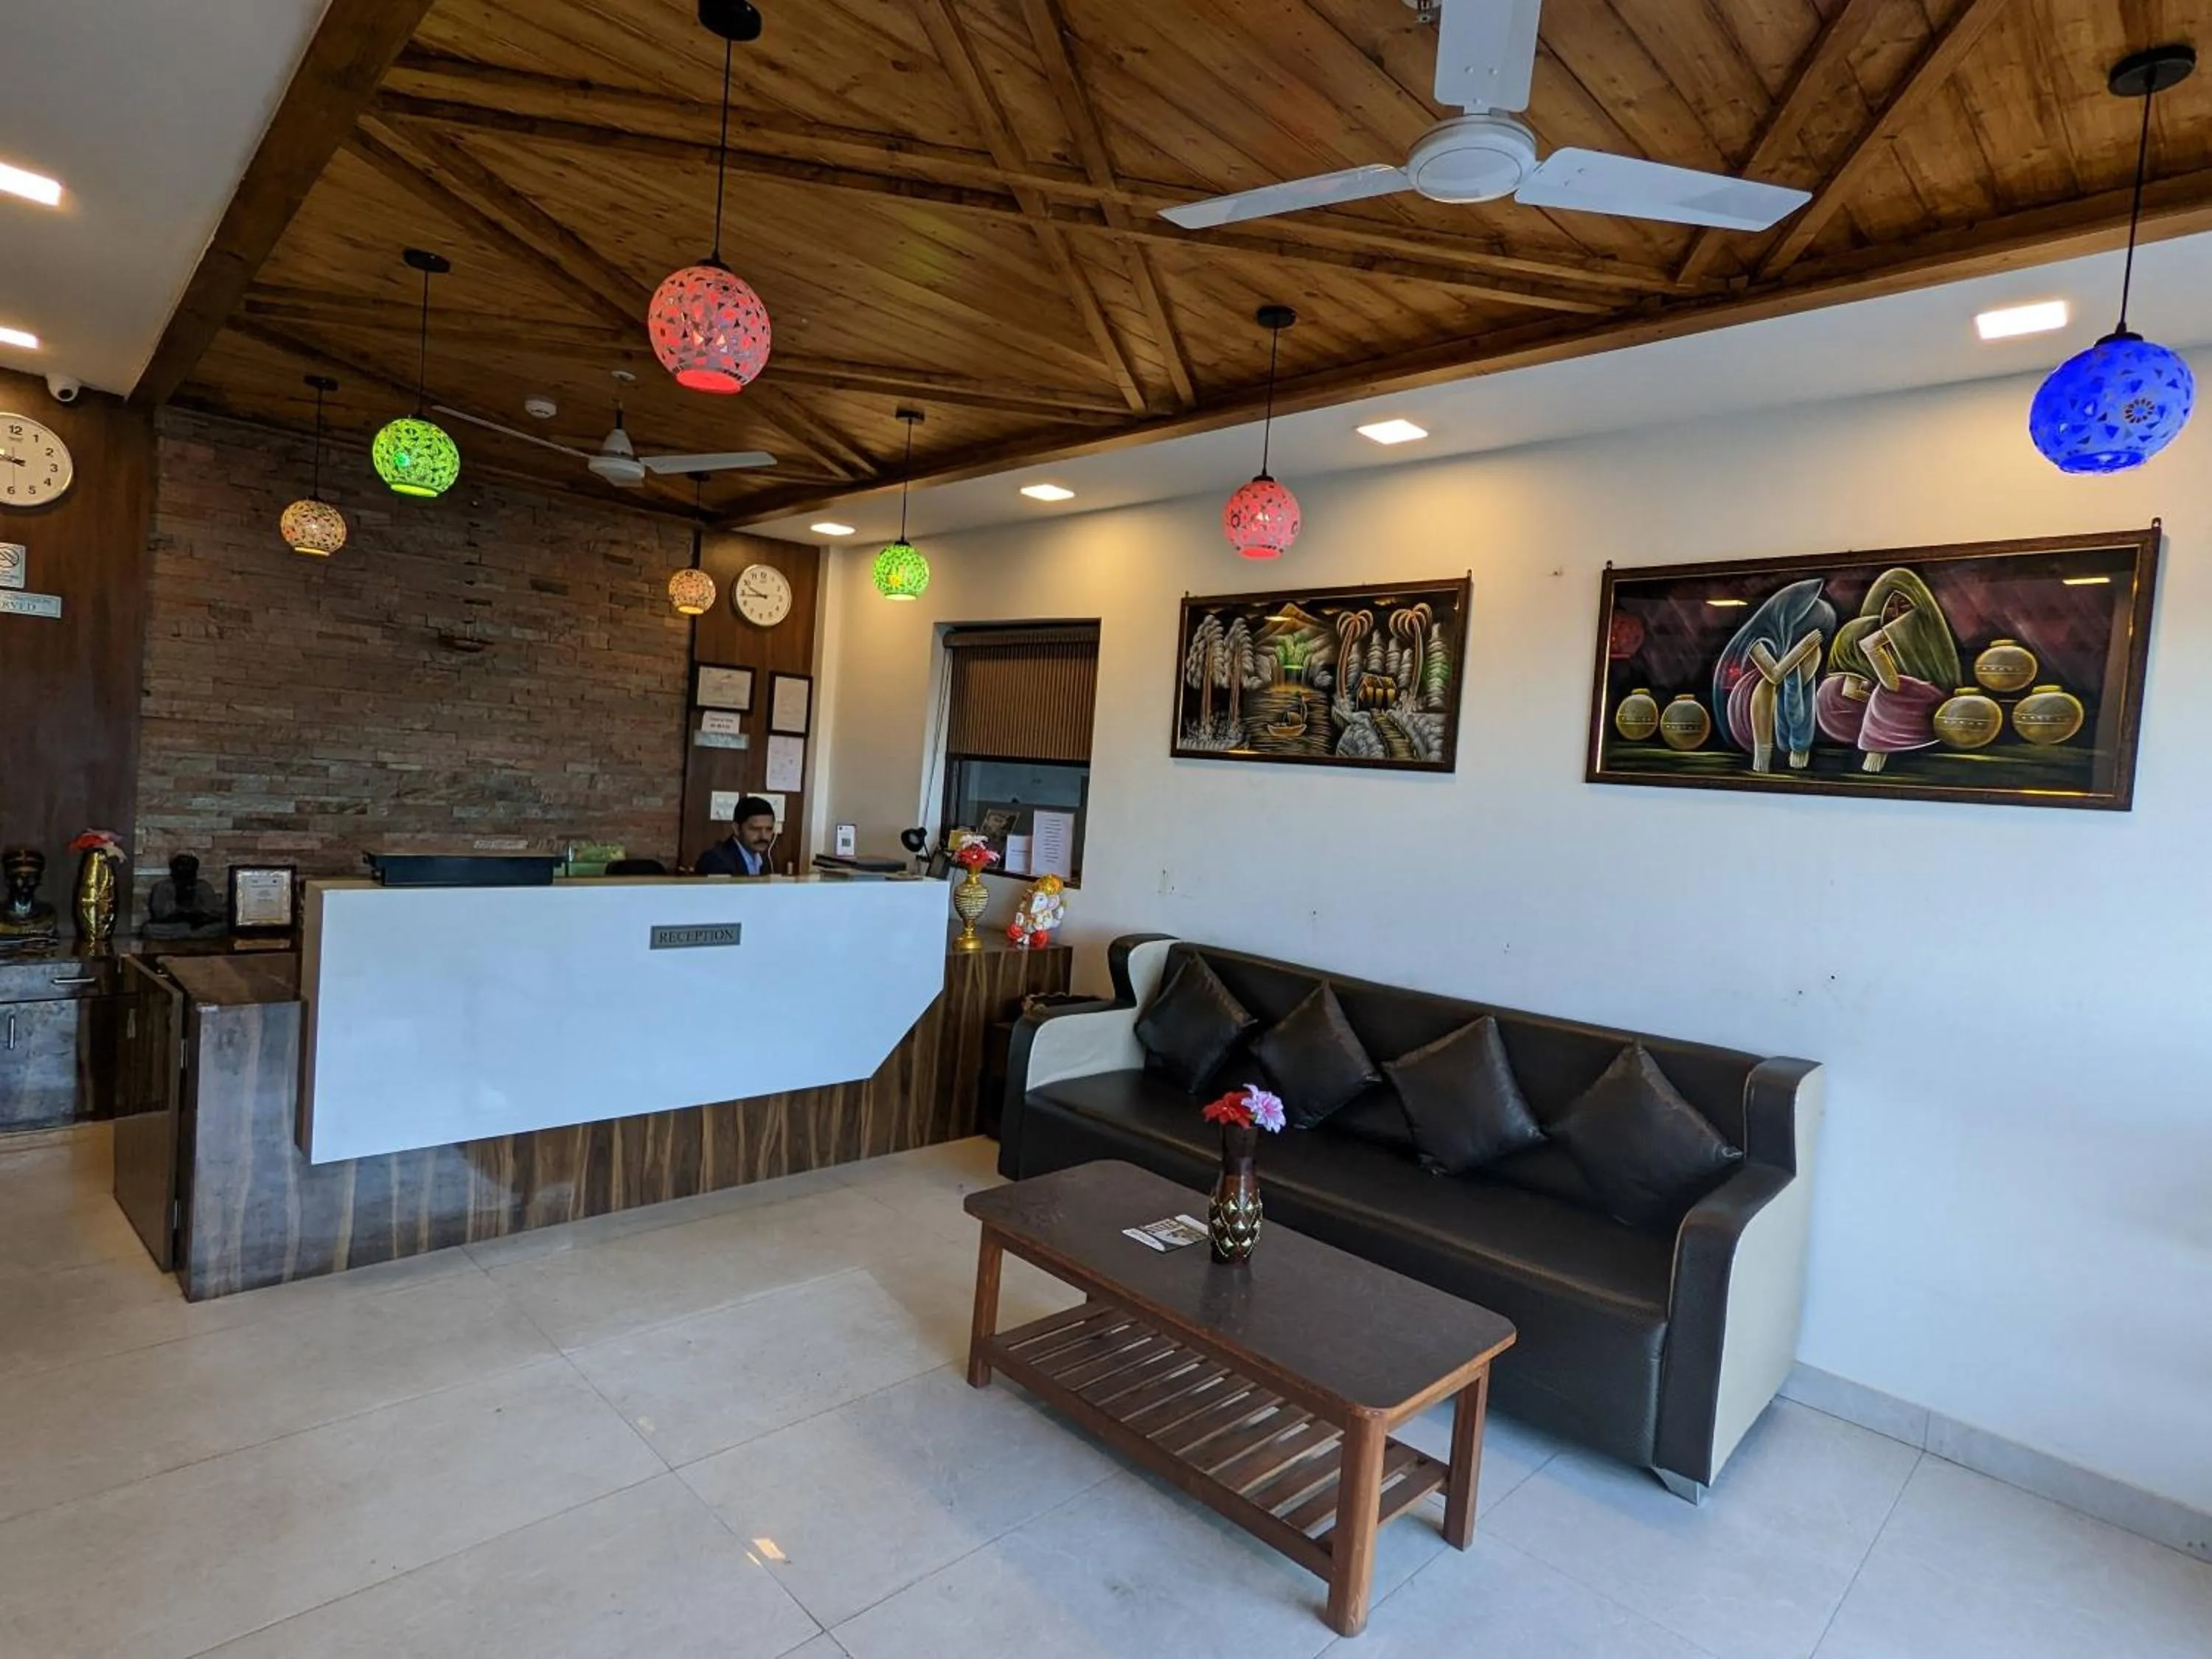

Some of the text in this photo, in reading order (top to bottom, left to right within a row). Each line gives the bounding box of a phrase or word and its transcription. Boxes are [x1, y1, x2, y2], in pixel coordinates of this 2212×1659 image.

[8, 425, 23, 435] 12
[33, 434, 39, 442] 1
[45, 448, 54, 458] 2
[49, 463, 58, 473] 3
[44, 477, 52, 487] 4
[7, 486, 15, 495] 6
[28, 484, 36, 495] 5
[659, 928, 734, 944] RECEPTION
